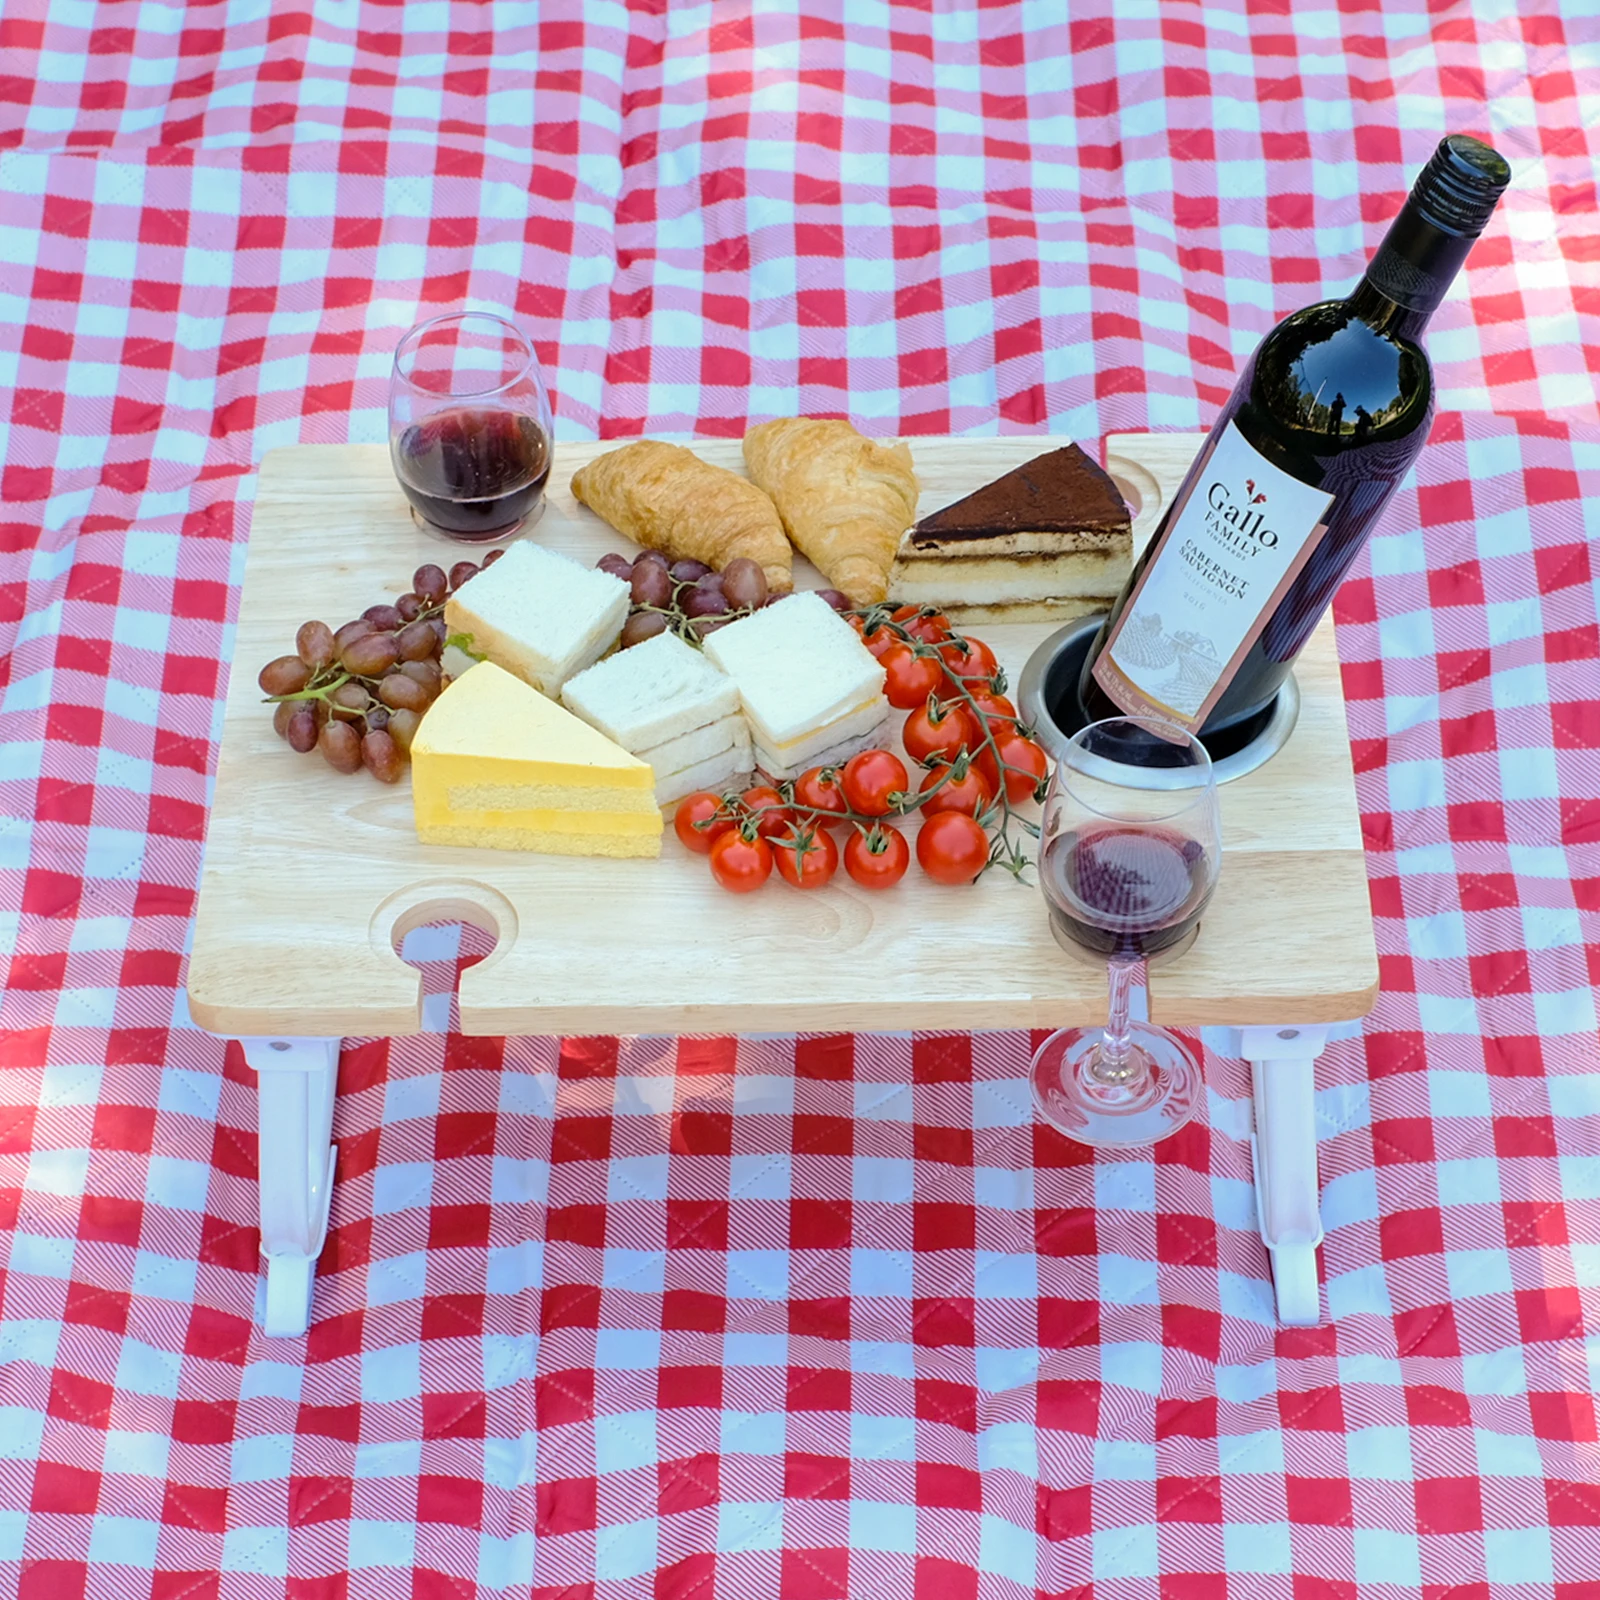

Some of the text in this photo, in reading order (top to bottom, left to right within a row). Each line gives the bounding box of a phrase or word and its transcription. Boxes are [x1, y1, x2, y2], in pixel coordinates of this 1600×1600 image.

[1205, 511, 1261, 557] FAMILY
[1208, 482, 1278, 548] Gallo
[1186, 538, 1250, 589] CABERNET
[1206, 529, 1247, 562] VINEYARDS
[1179, 546, 1246, 599] SAUVIGNON
[1180, 566, 1227, 605] CALIFORNIA
